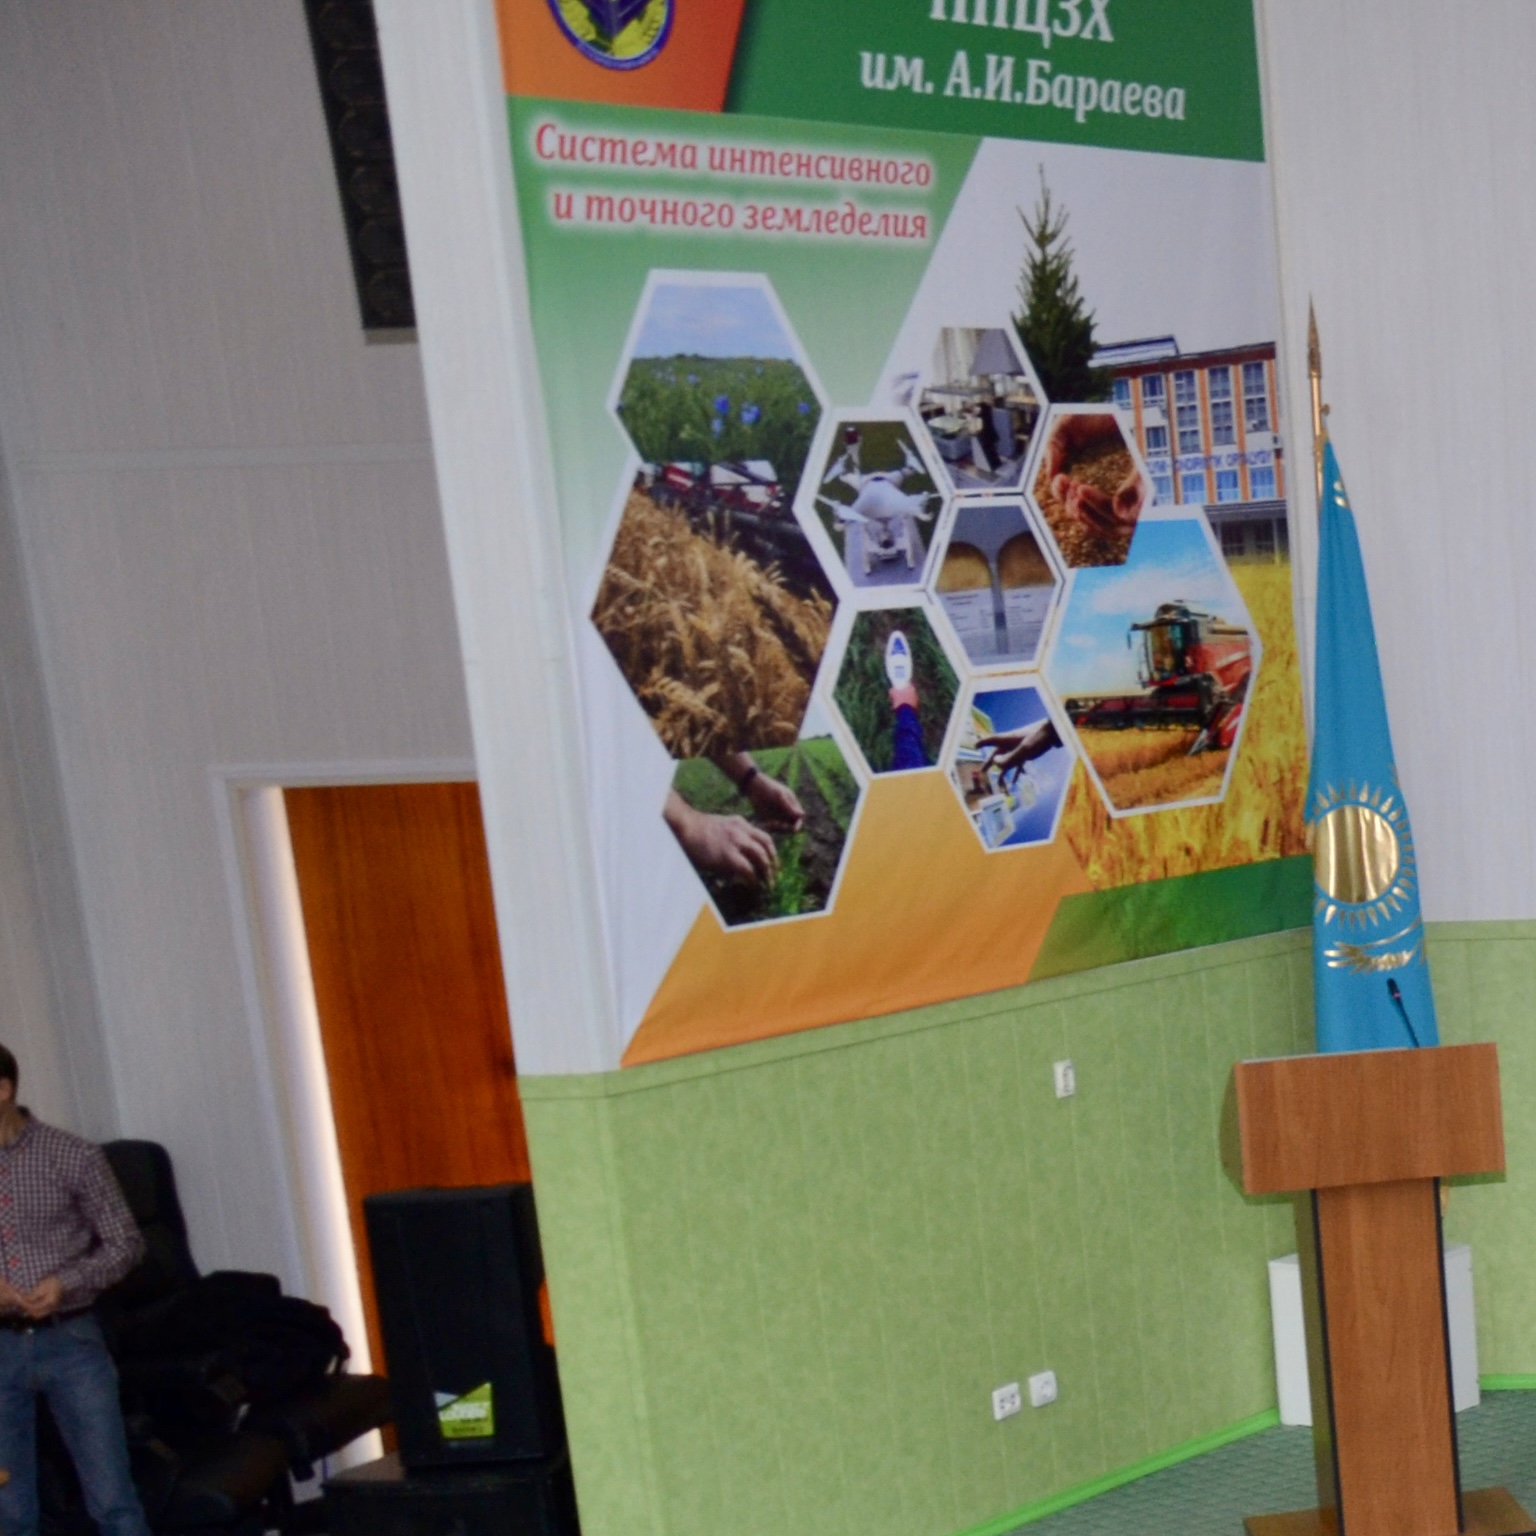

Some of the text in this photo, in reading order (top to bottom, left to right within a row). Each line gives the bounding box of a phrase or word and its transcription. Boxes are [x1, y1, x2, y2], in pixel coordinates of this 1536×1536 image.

[860, 50, 1186, 123] им. А.И.Бараева
[535, 122, 931, 188] Система интенсивного
[554, 192, 927, 240] и точного земледелия
